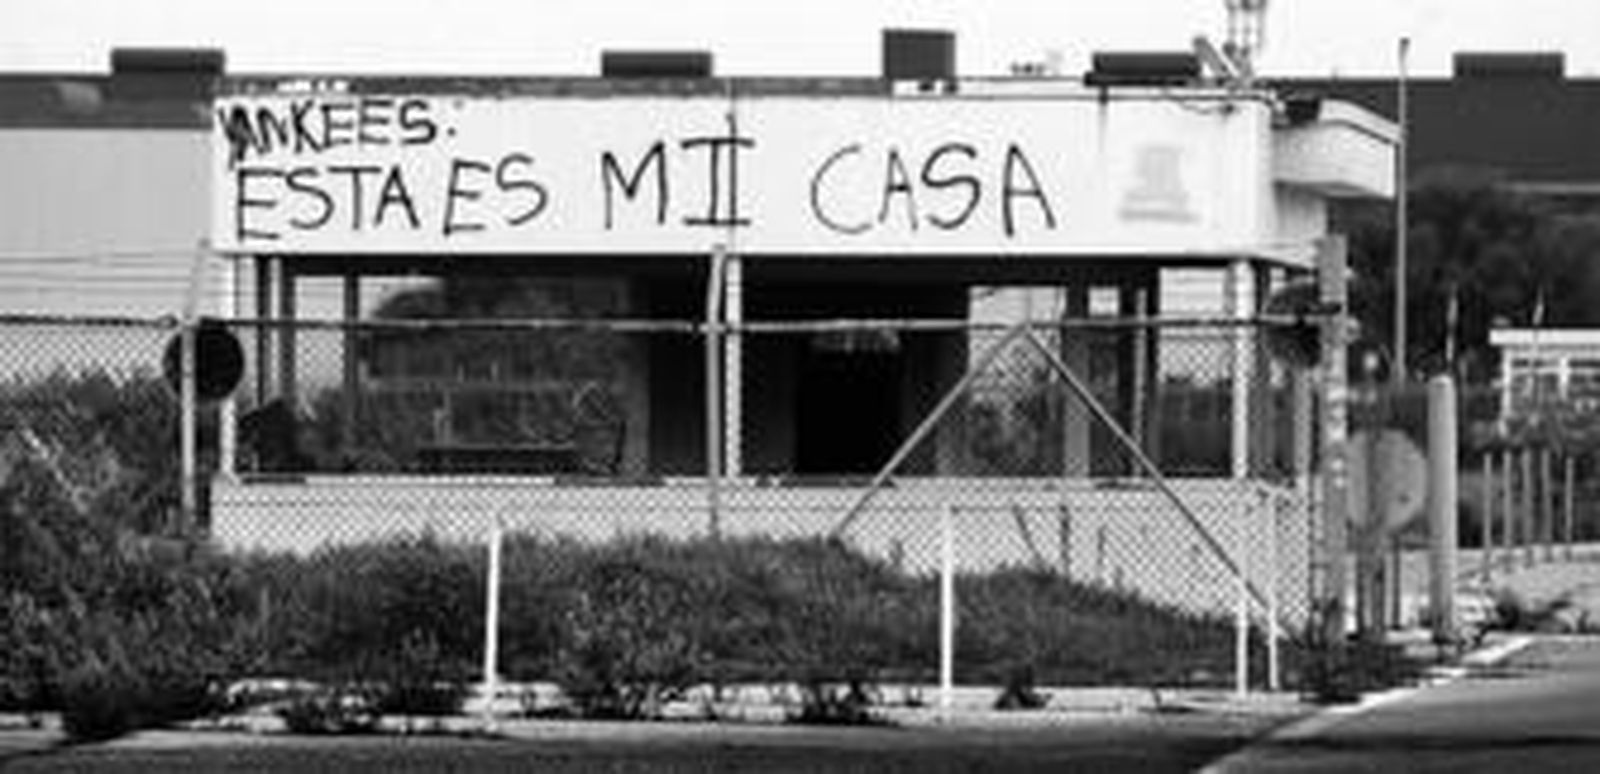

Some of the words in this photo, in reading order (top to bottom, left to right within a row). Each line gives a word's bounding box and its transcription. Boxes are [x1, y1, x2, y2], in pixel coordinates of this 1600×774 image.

[229, 166, 420, 241] ESTA
[442, 153, 549, 236] ES
[810, 142, 1055, 237] CASA
